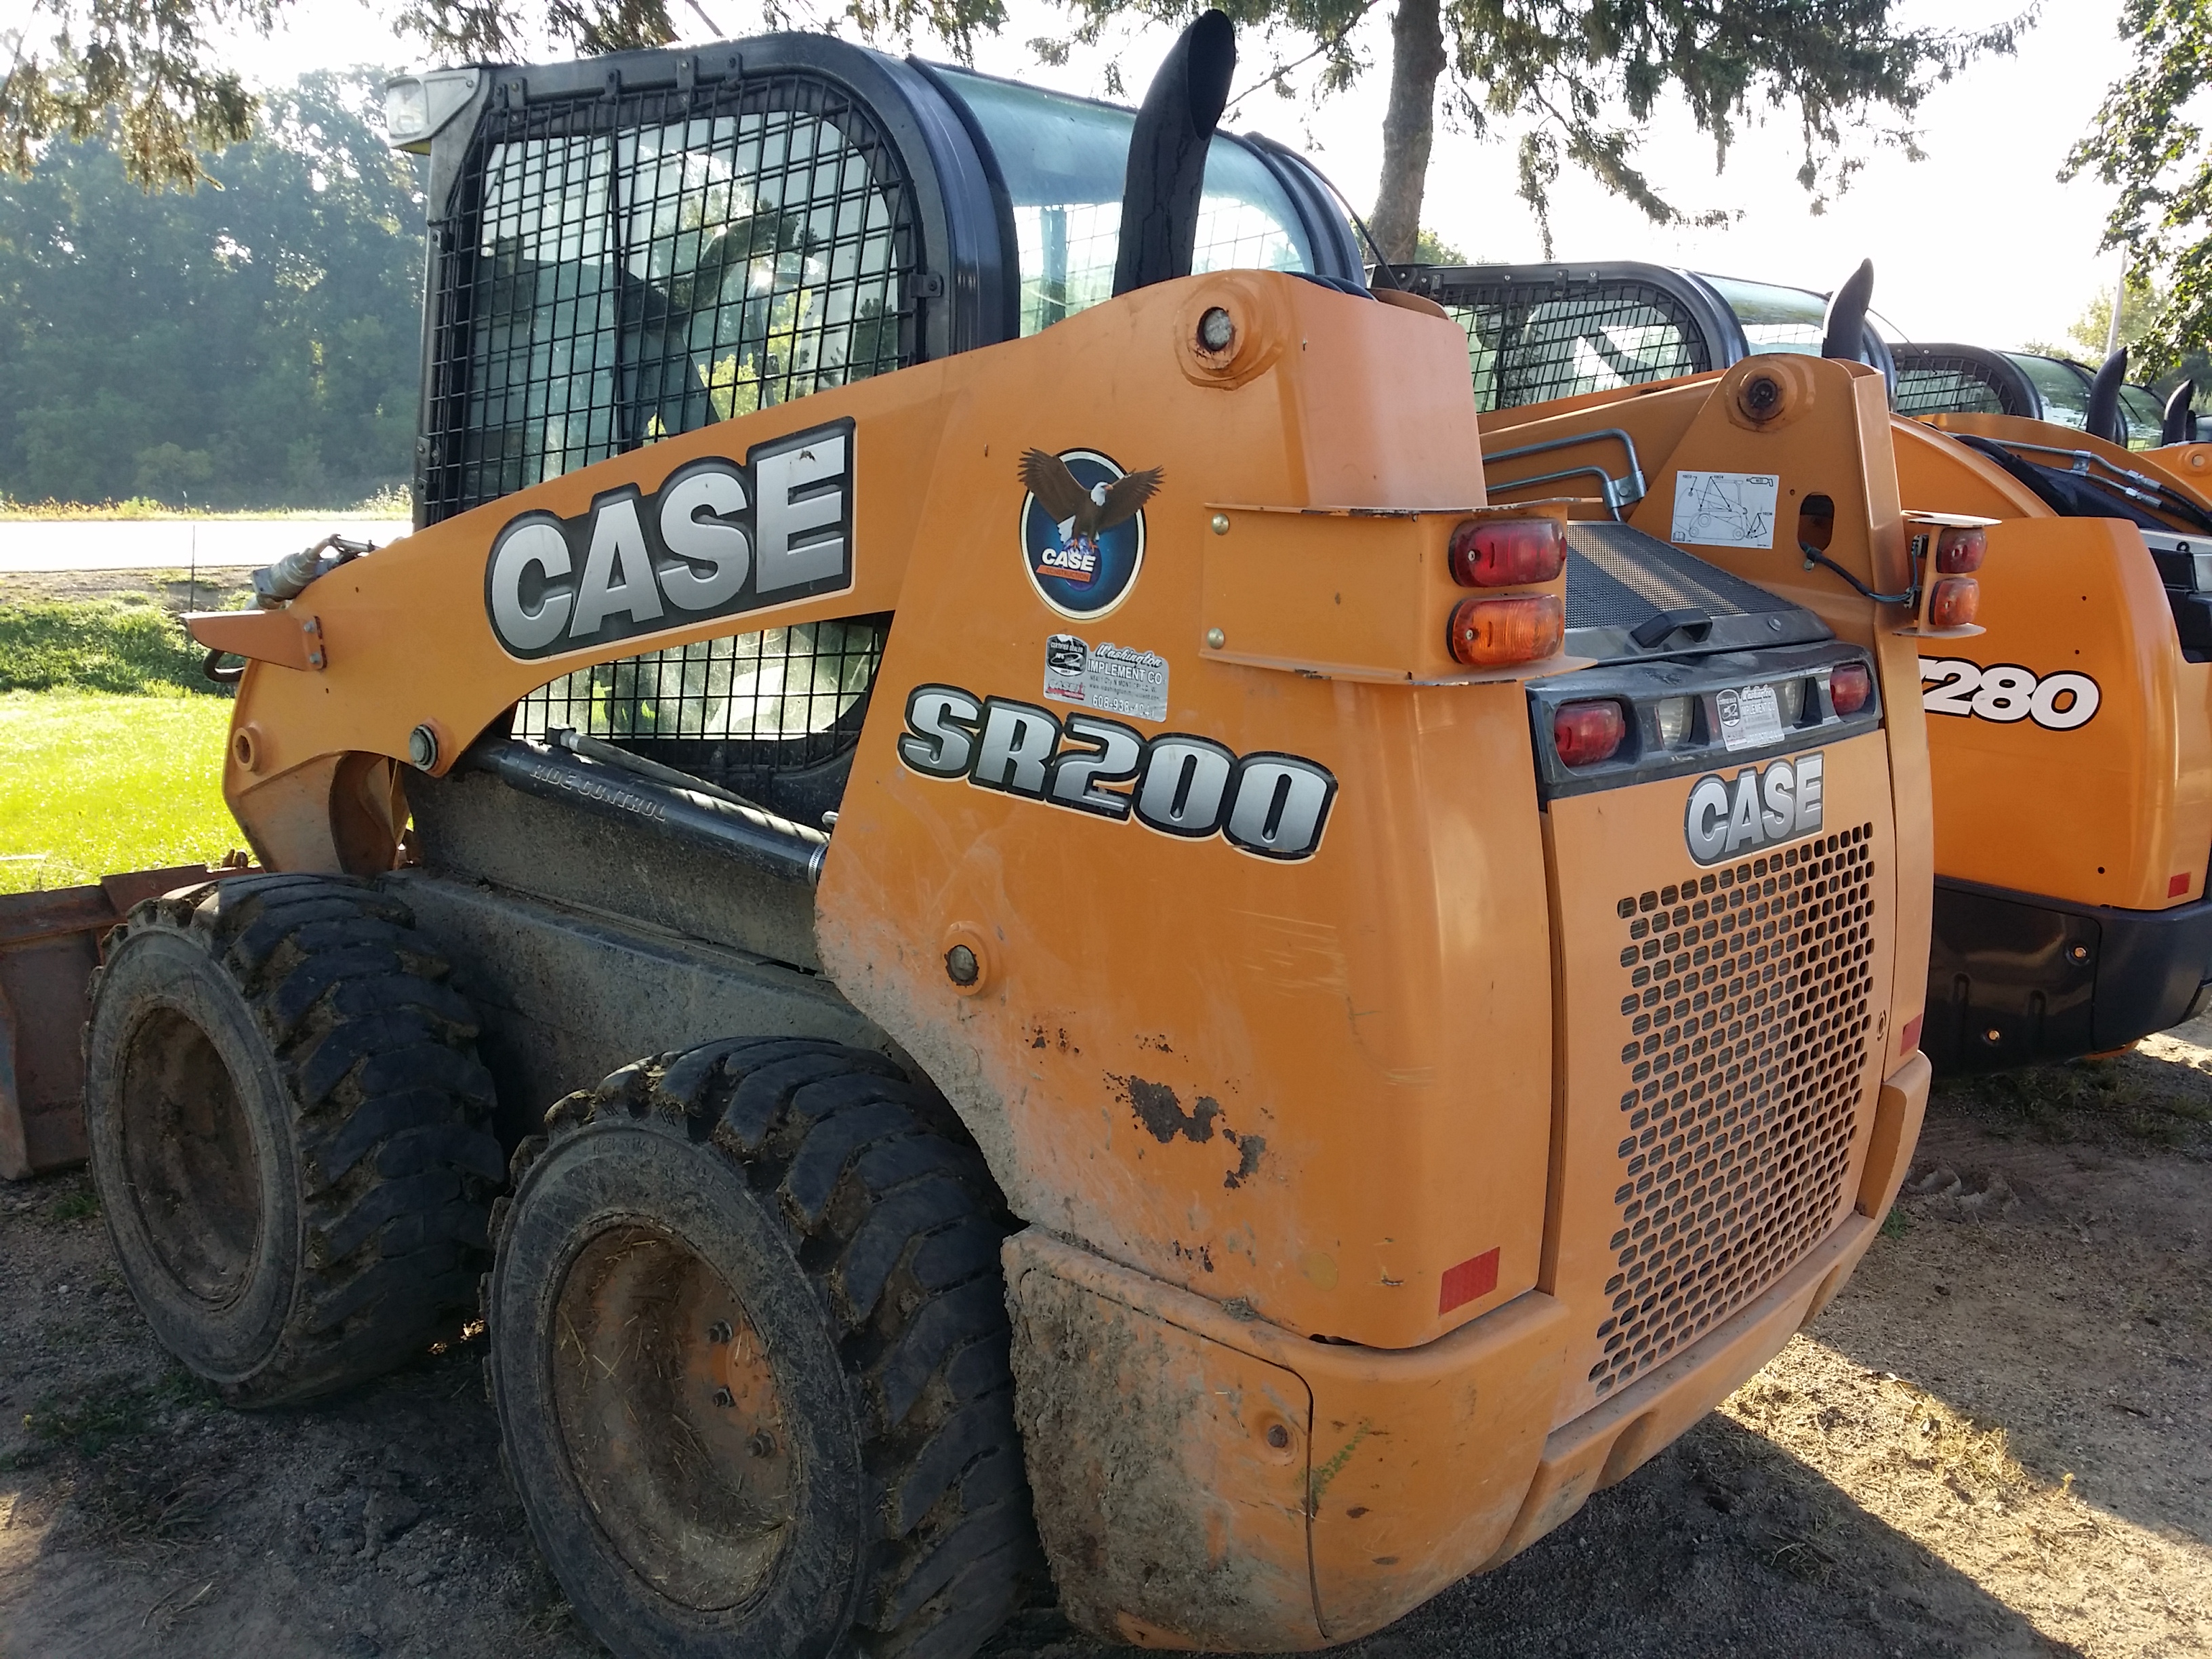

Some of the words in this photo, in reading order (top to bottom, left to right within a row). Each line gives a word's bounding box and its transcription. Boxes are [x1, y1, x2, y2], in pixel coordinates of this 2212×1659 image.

[488, 424, 851, 657] CASE
[1042, 548, 1097, 572] CASE
[1046, 567, 1089, 580] CONSTRUCTION
[1050, 641, 1069, 651] CERTIFIED
[1069, 644, 1084, 654] DEALER
[1095, 644, 1163, 668] Washington
[1088, 659, 1146, 682] IMPLEMENT
[1919, 657, 2102, 730] 280
[900, 686, 1334, 859] SR200
[1686, 754, 1824, 863] CASE
